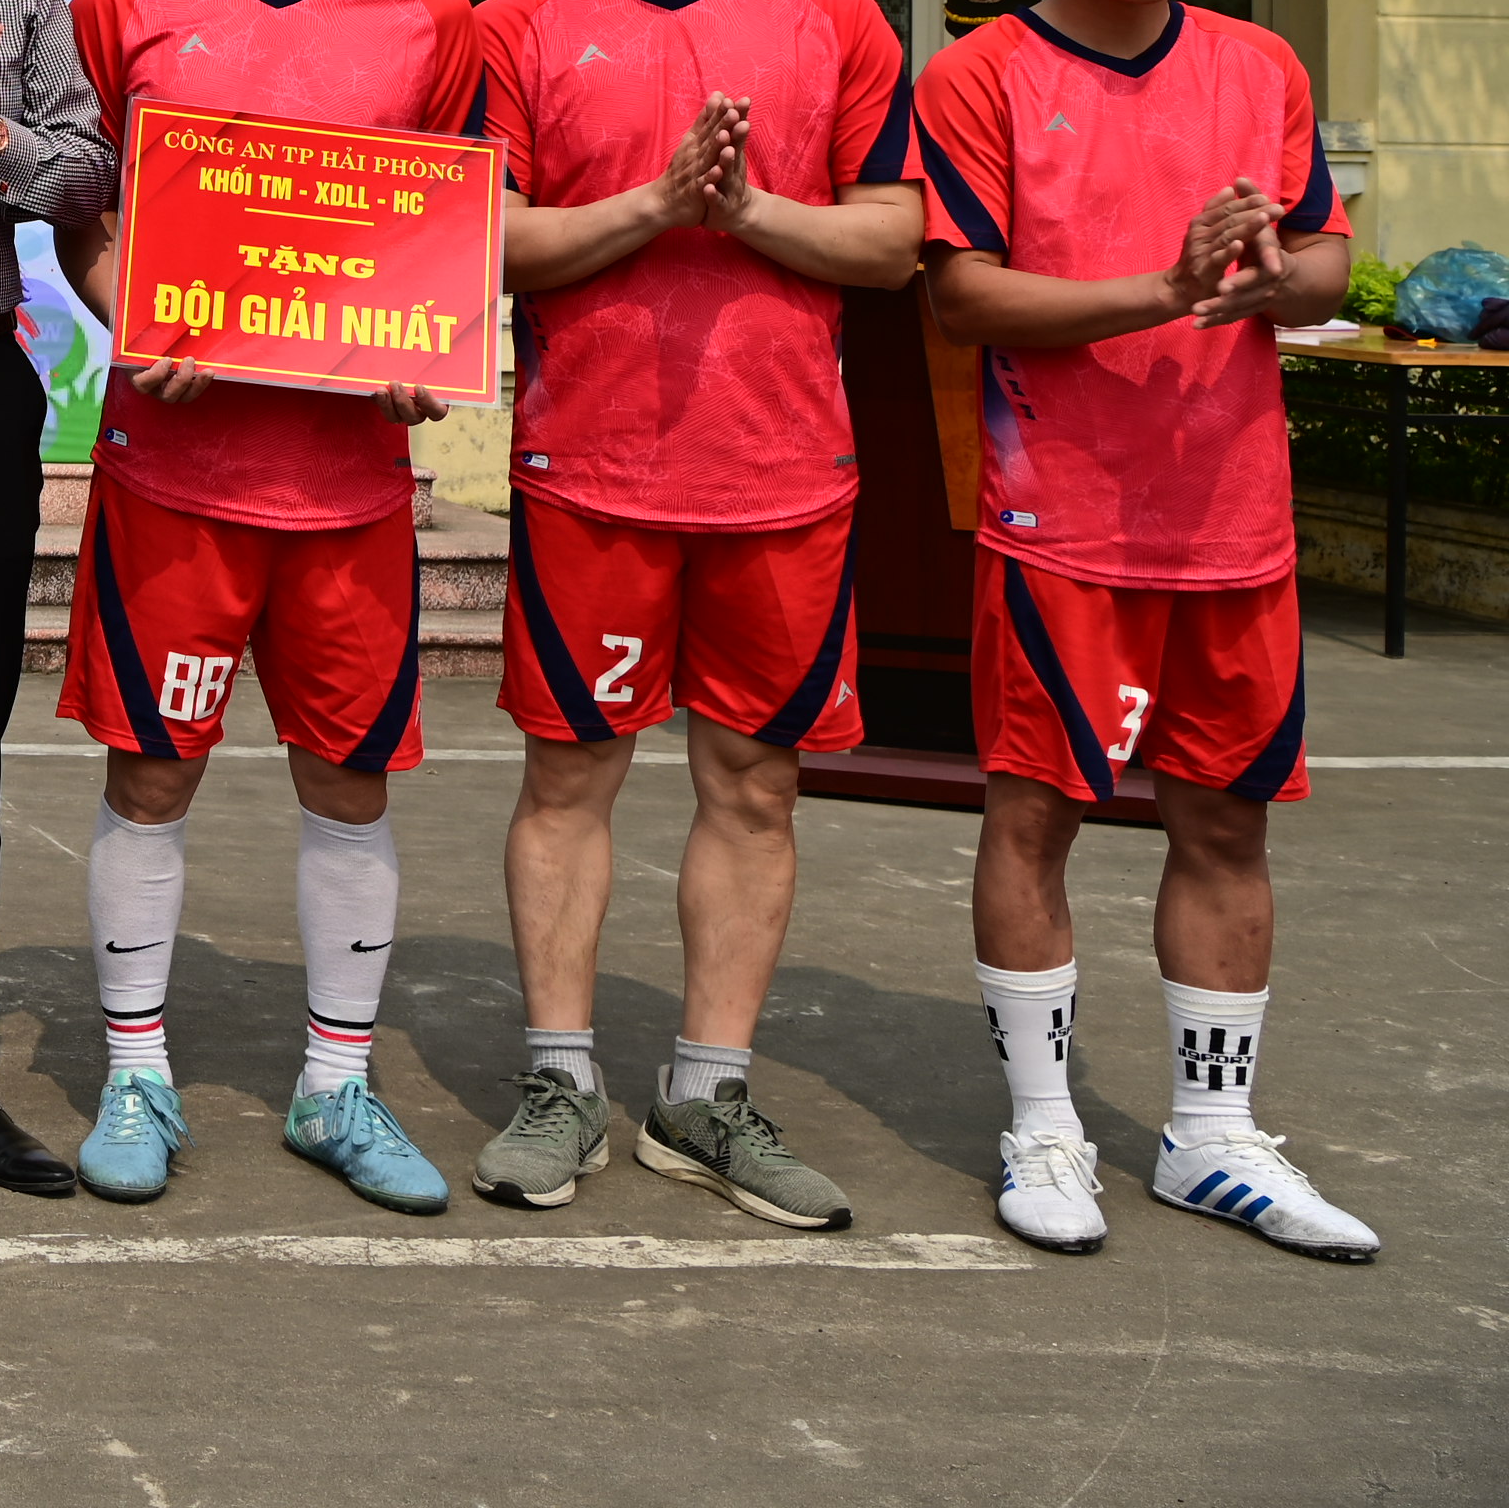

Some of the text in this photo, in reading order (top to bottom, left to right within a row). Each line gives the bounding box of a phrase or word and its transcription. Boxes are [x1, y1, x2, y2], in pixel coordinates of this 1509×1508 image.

[164, 128, 466, 182] CÔNG AN TP HẢI PHÒNG
[199, 164, 253, 196] KHỐI
[259, 174, 293, 201] TM
[314, 180, 370, 210] XDLL
[393, 190, 425, 216] HC
[238, 244, 376, 279] TẶNG
[153, 280, 458, 355] ĐỘI GIẢI NHẤT
[159, 652, 234, 721] 88
[594, 634, 643, 702] 2
[1107, 684, 1149, 761] 3
